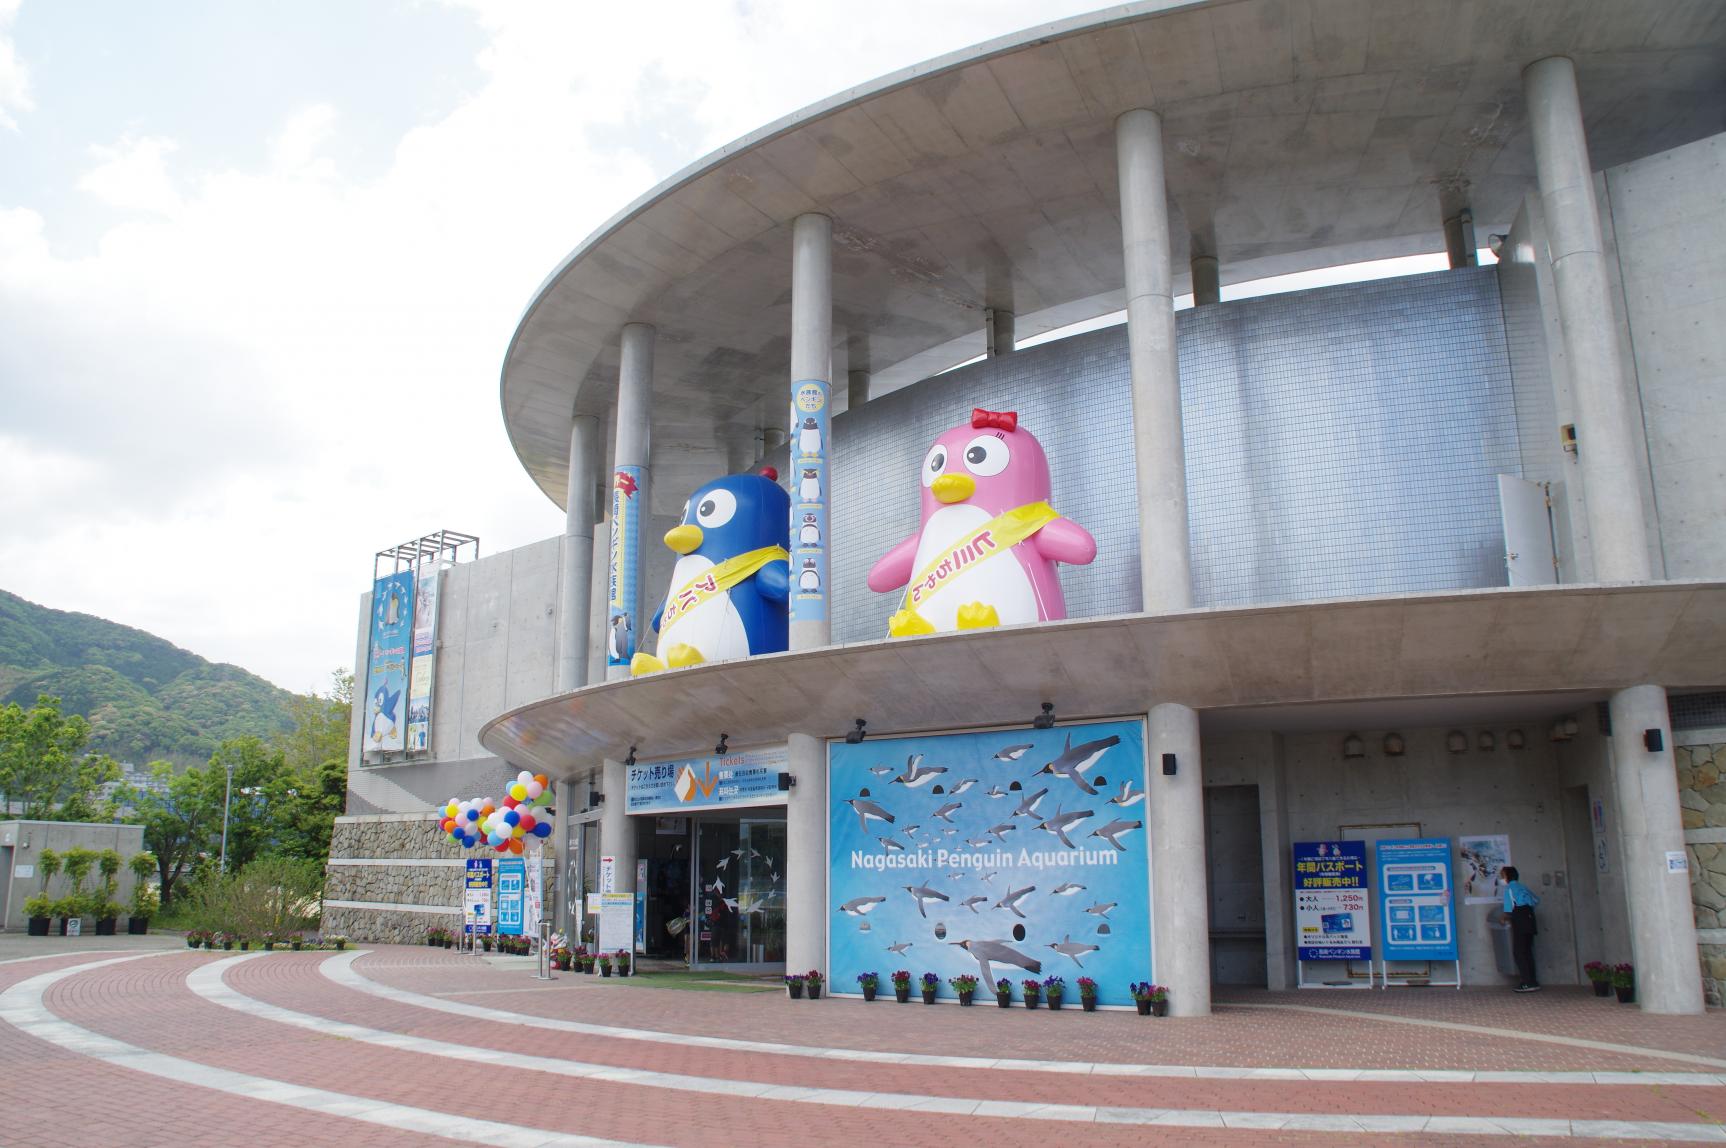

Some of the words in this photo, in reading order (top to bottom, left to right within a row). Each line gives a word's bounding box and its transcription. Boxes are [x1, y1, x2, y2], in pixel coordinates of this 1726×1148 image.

[719, 755, 745, 767] Tickets
[631, 764, 675, 782] チケット売り場
[851, 850, 932, 872] Nagasaki
[938, 849, 1013, 871] Penguin
[1018, 847, 1118, 870] Aquarium
[1297, 861, 1363, 872] 年間パスポート
